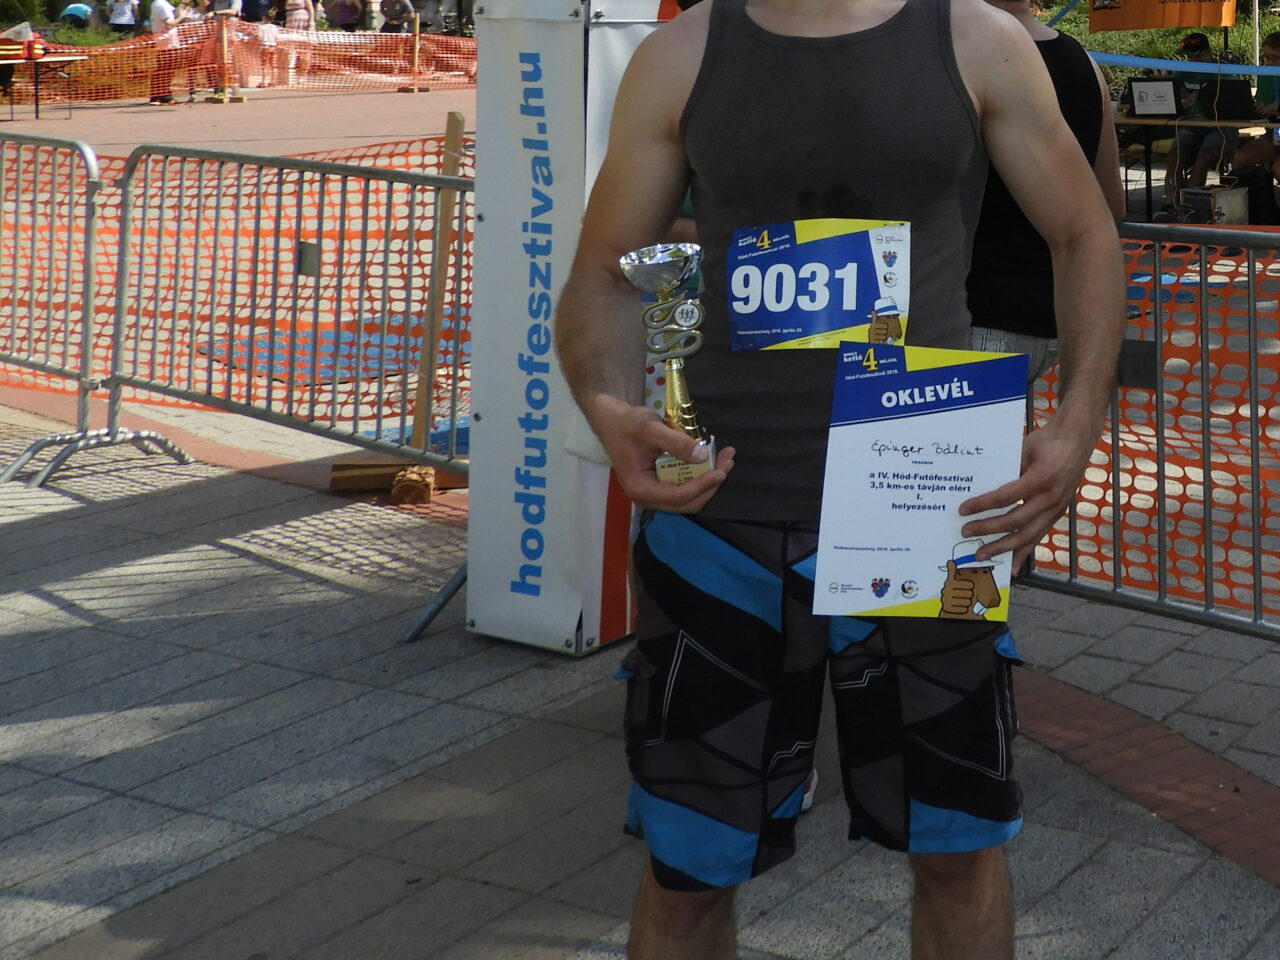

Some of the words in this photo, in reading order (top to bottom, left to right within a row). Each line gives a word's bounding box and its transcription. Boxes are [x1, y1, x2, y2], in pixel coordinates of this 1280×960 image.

[731, 262, 858, 314] 9031
[510, 51, 553, 596] hodfutofesztival.hu
[862, 347, 879, 371] 4
[881, 377, 974, 408] OKLEVÉL
[869, 482, 884, 490] 3,5
[887, 482, 915, 490] km-es
[917, 482, 946, 492] távján
[949, 484, 971, 492] elért
[892, 472, 973, 482] Hód-Futófesztivál
[891, 502, 946, 511] helyezésért
